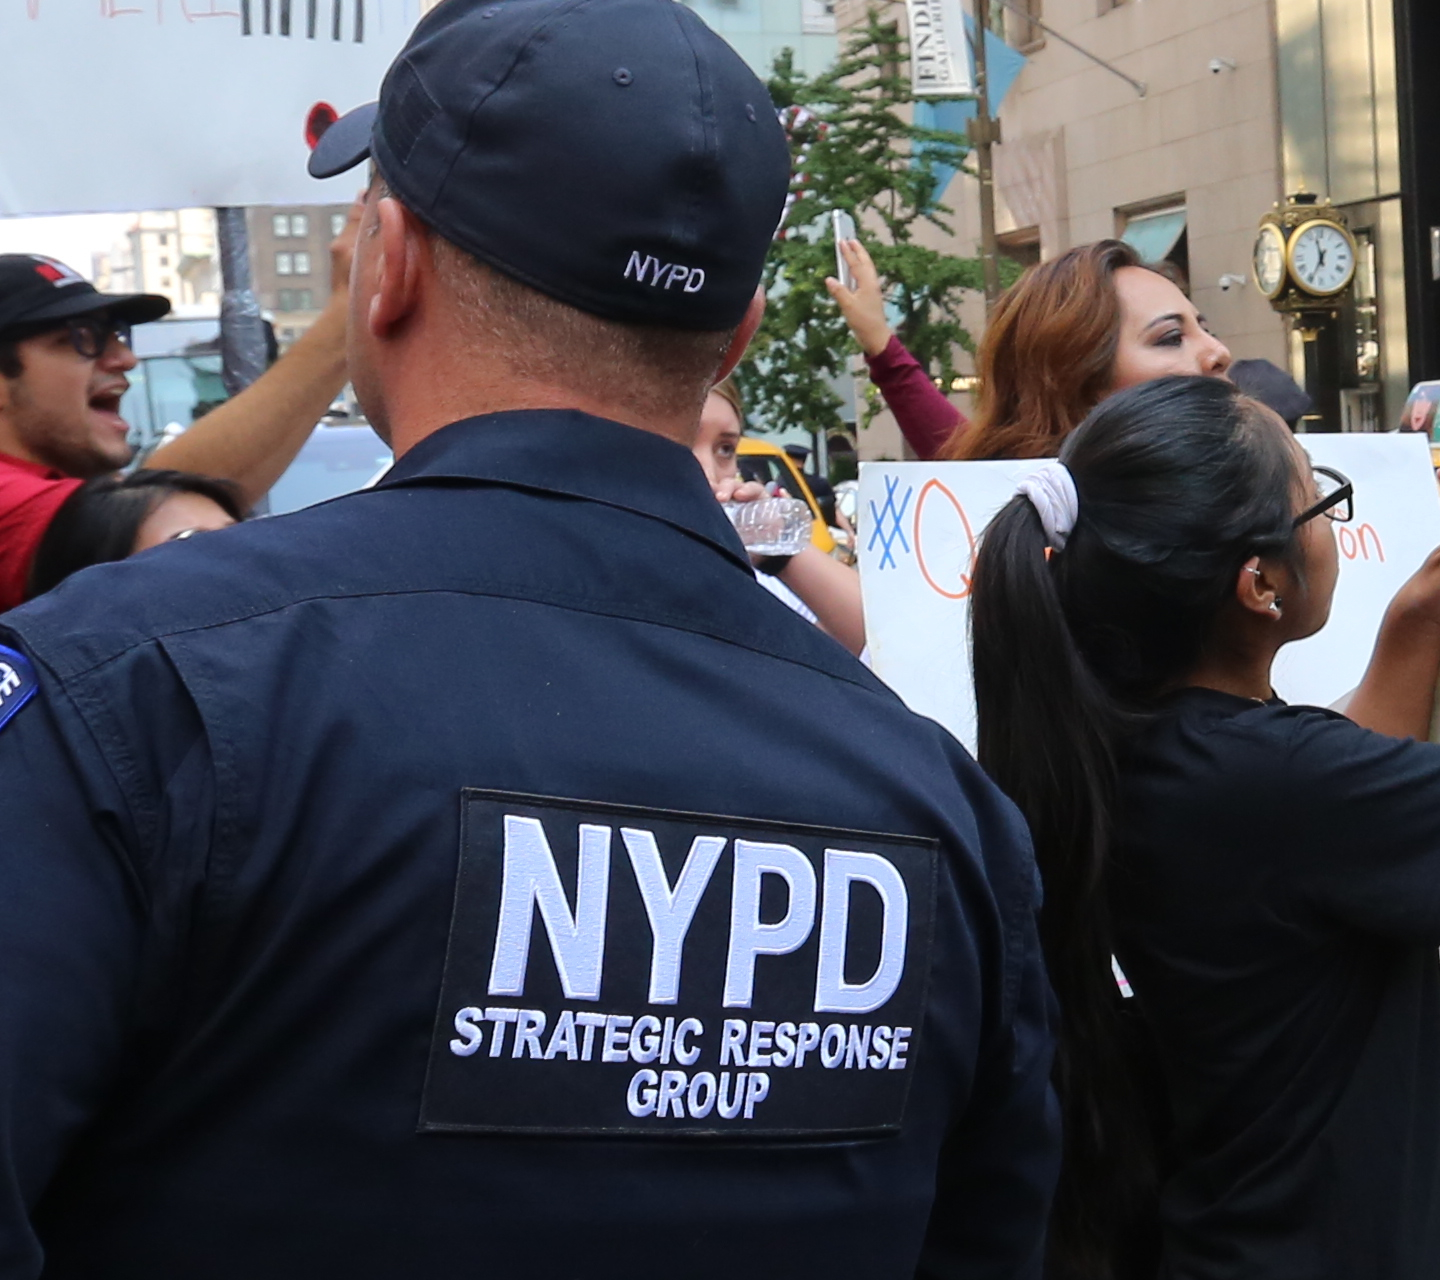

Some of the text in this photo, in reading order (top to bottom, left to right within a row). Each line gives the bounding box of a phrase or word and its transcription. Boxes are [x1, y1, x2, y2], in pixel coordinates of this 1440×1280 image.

[624, 251, 706, 293] NYPD
[488, 814, 909, 1014] NYPD
[449, 1006, 912, 1070] STRATEGIC RESPONSE
[627, 1069, 770, 1119] GROUP
